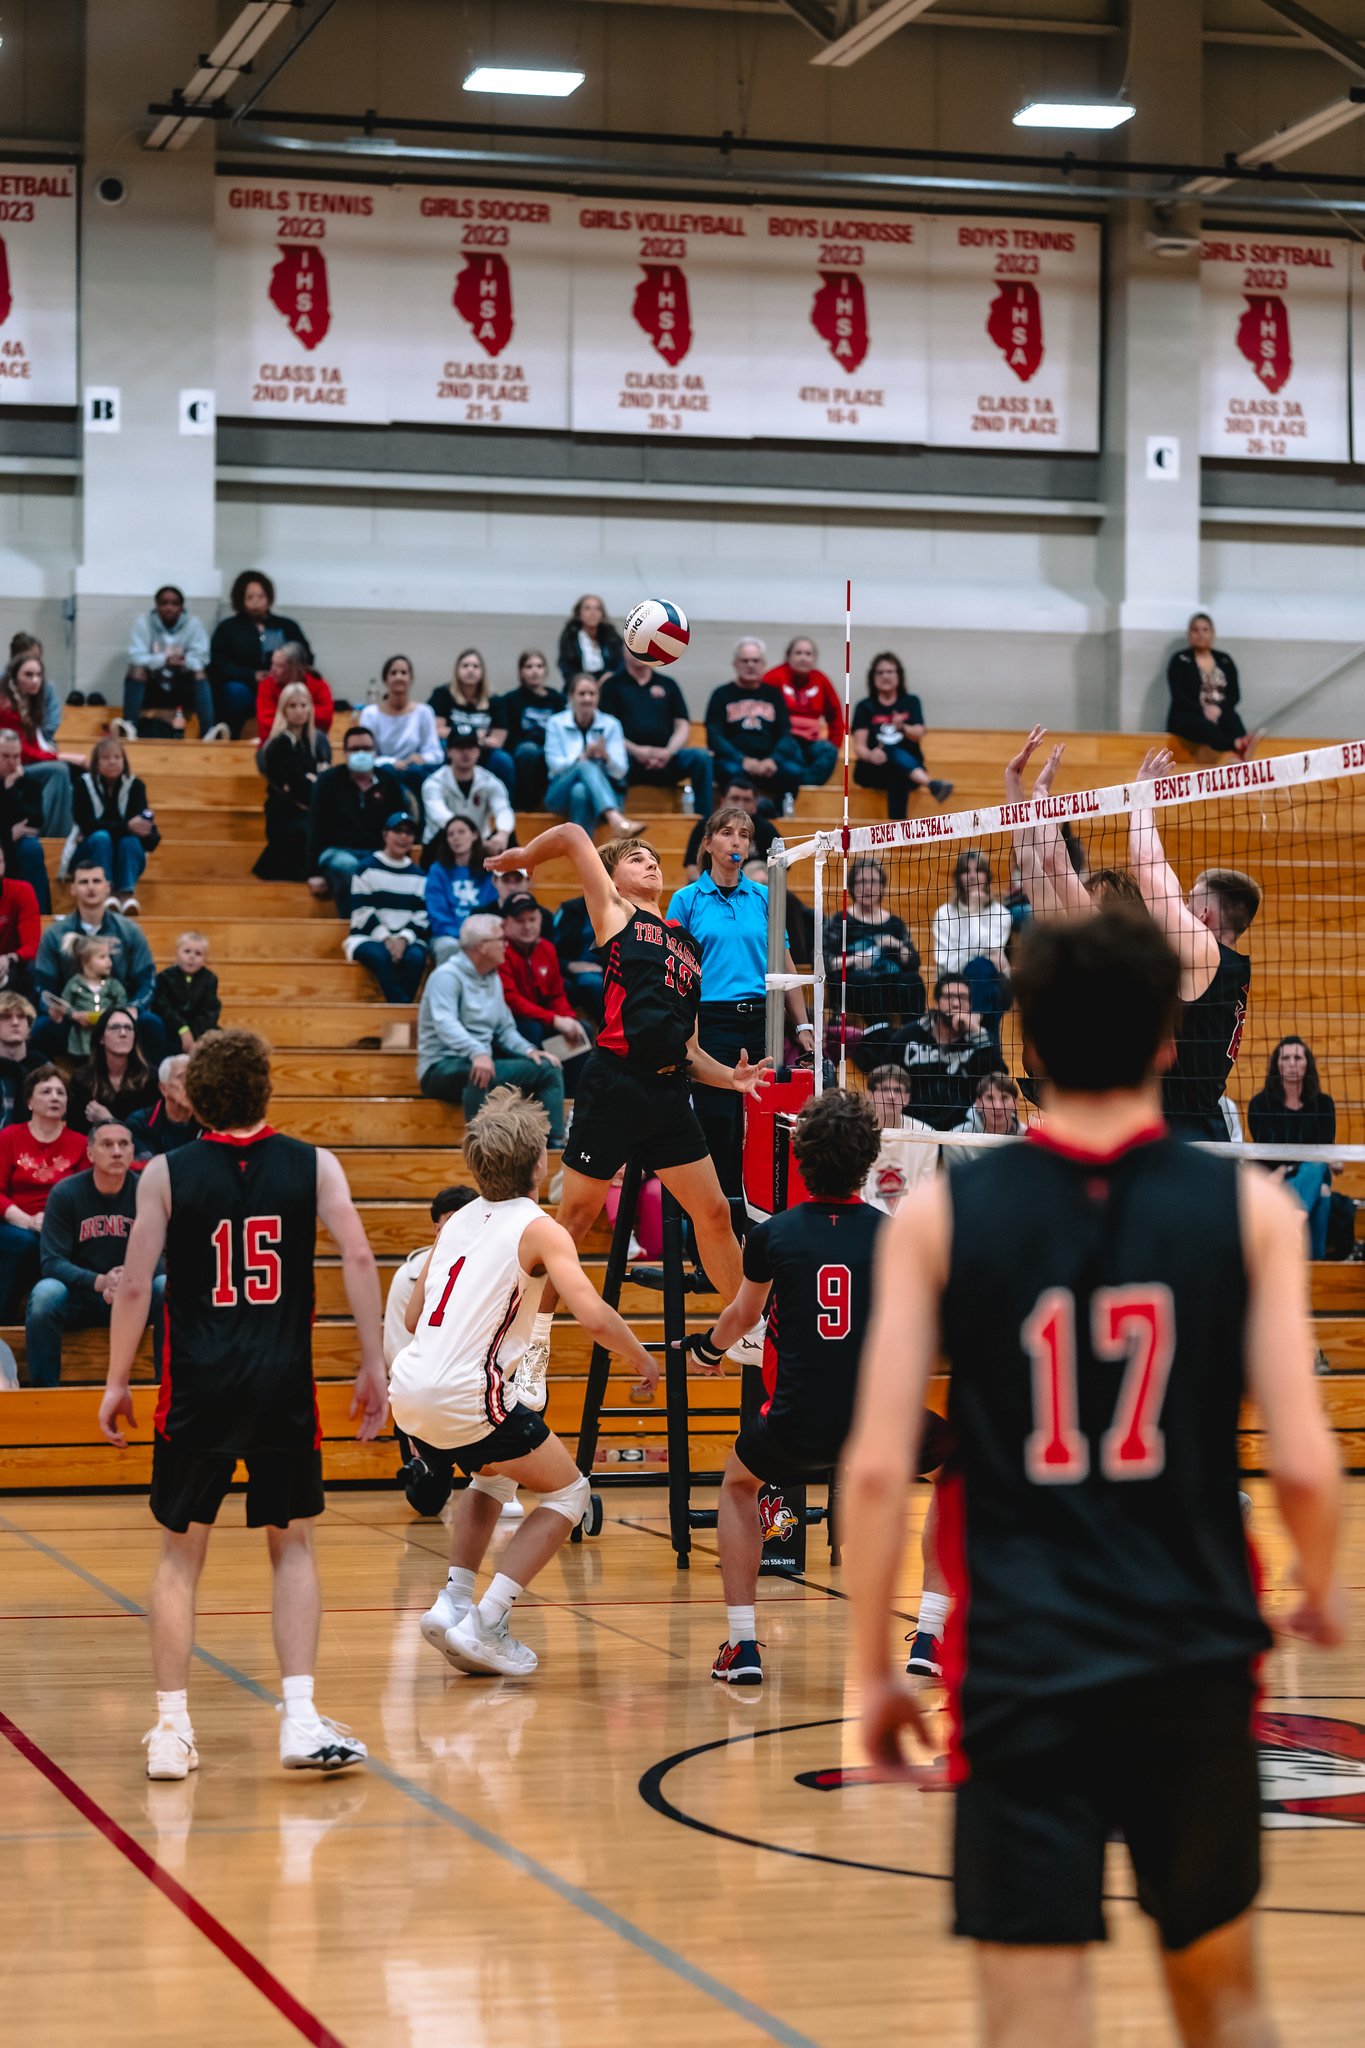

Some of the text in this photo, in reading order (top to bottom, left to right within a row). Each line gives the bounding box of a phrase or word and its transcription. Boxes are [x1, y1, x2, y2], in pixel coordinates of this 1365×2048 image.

[229, 188, 374, 216] GIRLS TENNIS
[420, 197, 551, 225] GIRLS SOCCER
[278, 216, 326, 239] 2023
[580, 208, 746, 237] GIRLS VOLLEYBALL
[768, 217, 914, 244] BOYS LACROSSE
[461, 224, 510, 246] 2023
[958, 227, 1076, 252] BOYS TENNIS
[639, 237, 687, 259] 2023
[818, 245, 864, 266] 2023
[1201, 241, 1334, 269] GIRLS SOFTBALL
[995, 253, 1039, 275] 2023
[1243, 268, 1288, 290] 2023
[295, 251, 313, 333] IHSA
[479, 259, 496, 340] IHSA
[658, 271, 675, 350] IHSA
[836, 278, 853, 358] IHSA
[1011, 287, 1028, 366] IHSA
[1260, 301, 1277, 379] IHSA
[260, 364, 342, 384] CLASS 1A
[444, 361, 525, 382] CLASS 2A
[625, 372, 705, 391] CLASS 4A
[252, 384, 347, 405] 2ND PLACE
[437, 381, 530, 402] 2ND PLACE
[619, 391, 710, 412] 2ND PLACE
[799, 386, 885, 408] 4TH PLACE
[91, 399, 113, 420] B
[187, 401, 208, 423] C
[977, 395, 1054, 415] CLASS 1A
[1229, 398, 1304, 417] CLASS 3A
[971, 414, 1058, 436] 2ND PLACE
[1224, 417, 1307, 437] 3RD PLACE
[1154, 447, 1172, 469] C
[1154, 760, 1275, 801] BENET VOLLEYBALL
[1000, 790, 1100, 826] BENET VOLLEYBALL
[870, 815, 954, 845] BENET VOLLEYBALL
[634, 922, 663, 946] THE
[210, 1214, 282, 1308] 15
[428, 1255, 466, 1328] 1
[816, 1263, 851, 1340] 9
[1019, 1281, 1177, 1486] 17
